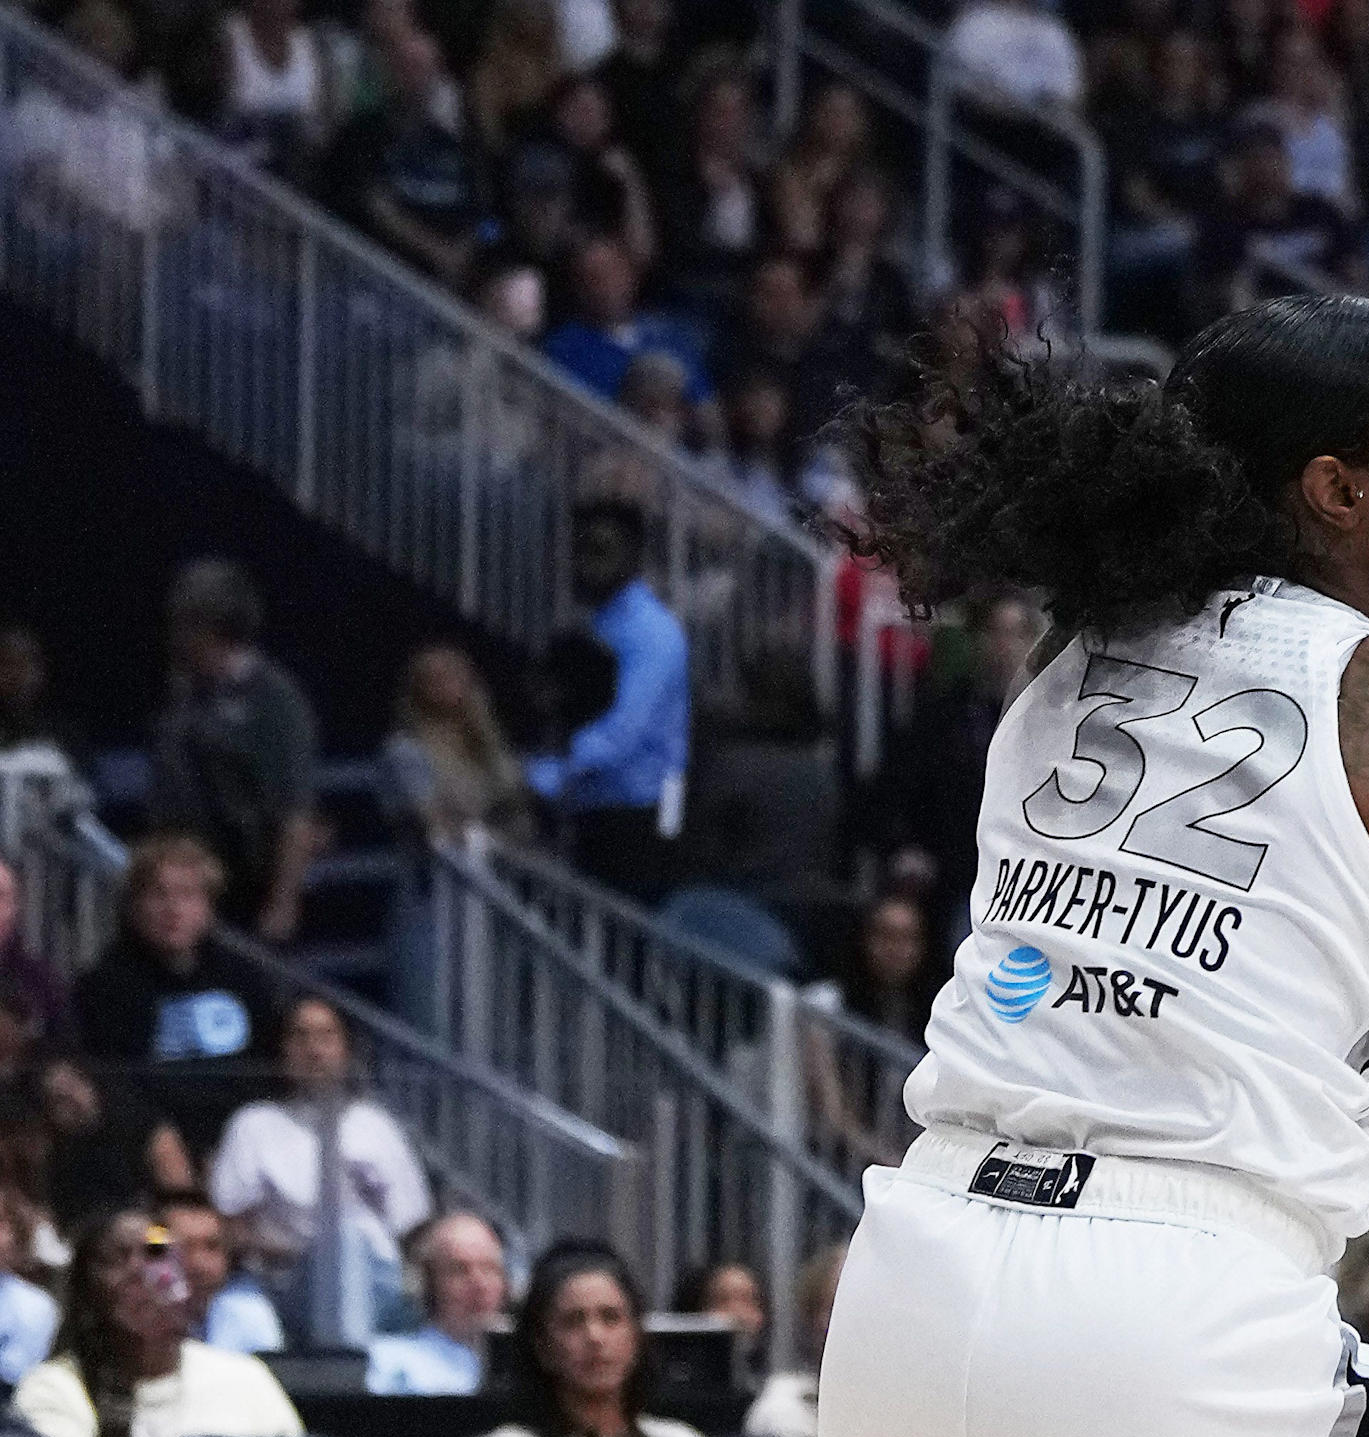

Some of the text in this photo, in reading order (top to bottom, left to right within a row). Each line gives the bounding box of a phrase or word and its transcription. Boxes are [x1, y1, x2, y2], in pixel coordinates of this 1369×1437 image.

[1023, 655, 1308, 892] 32
[982, 858, 1243, 973] PARKER-TYUS
[1051, 964, 1180, 1019] AT&T
